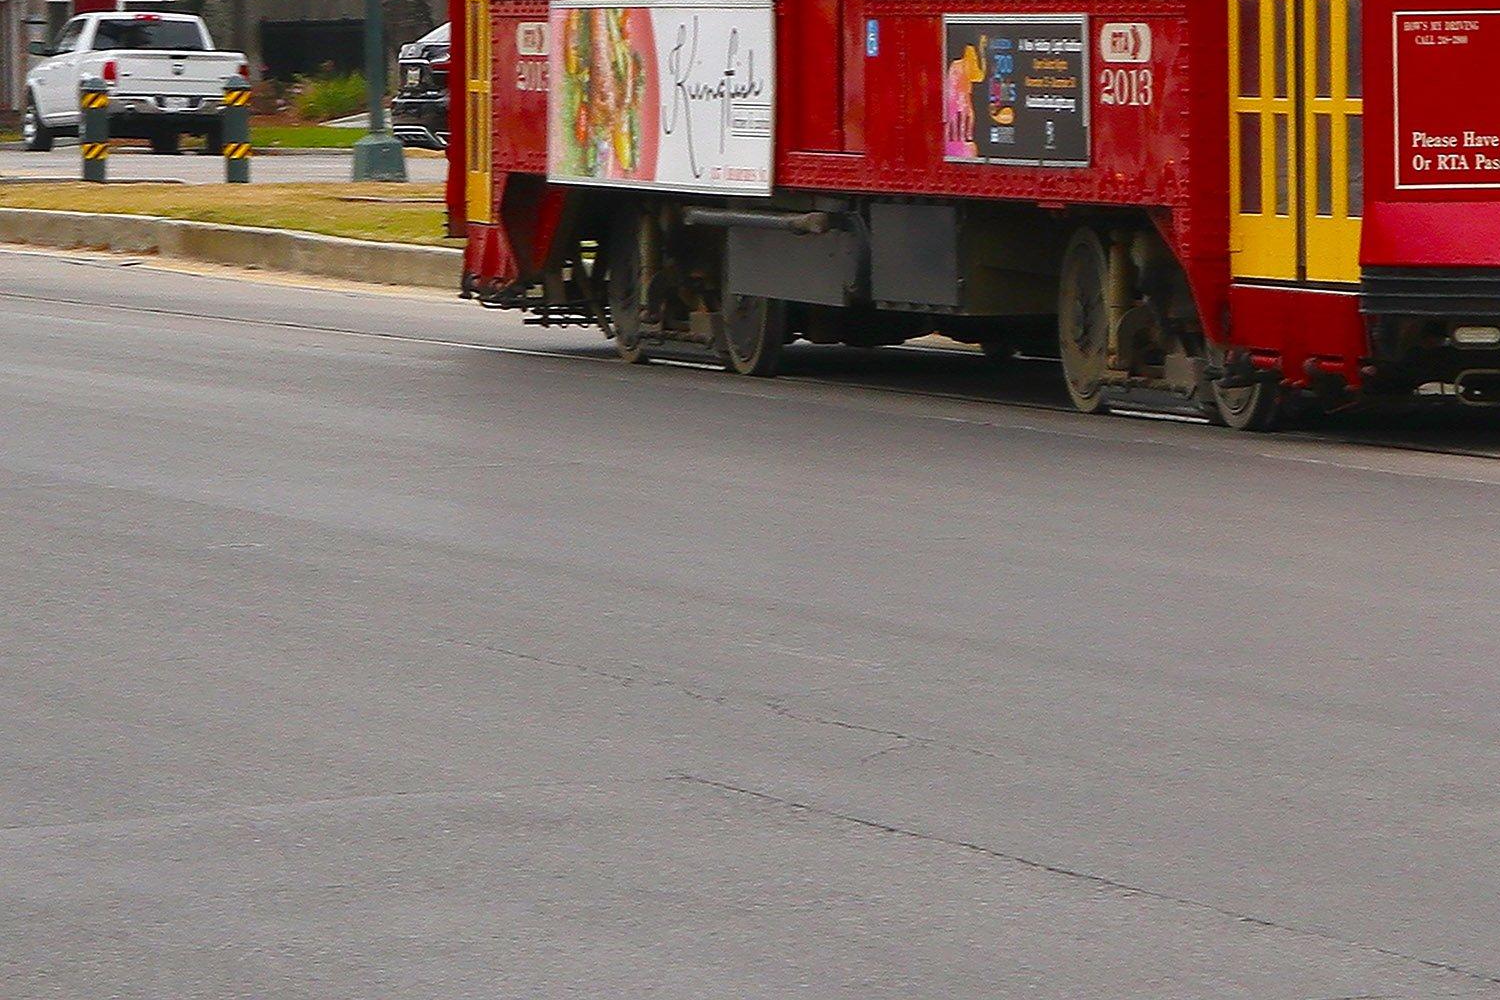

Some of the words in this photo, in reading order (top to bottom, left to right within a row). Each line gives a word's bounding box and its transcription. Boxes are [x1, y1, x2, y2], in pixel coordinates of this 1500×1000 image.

[1100, 68, 1153, 106] 2013
[1411, 131, 1458, 148] Please
[1462, 131, 1500, 147] Have
[1412, 154, 1432, 171] Or
[1437, 154, 1470, 170] RTA
